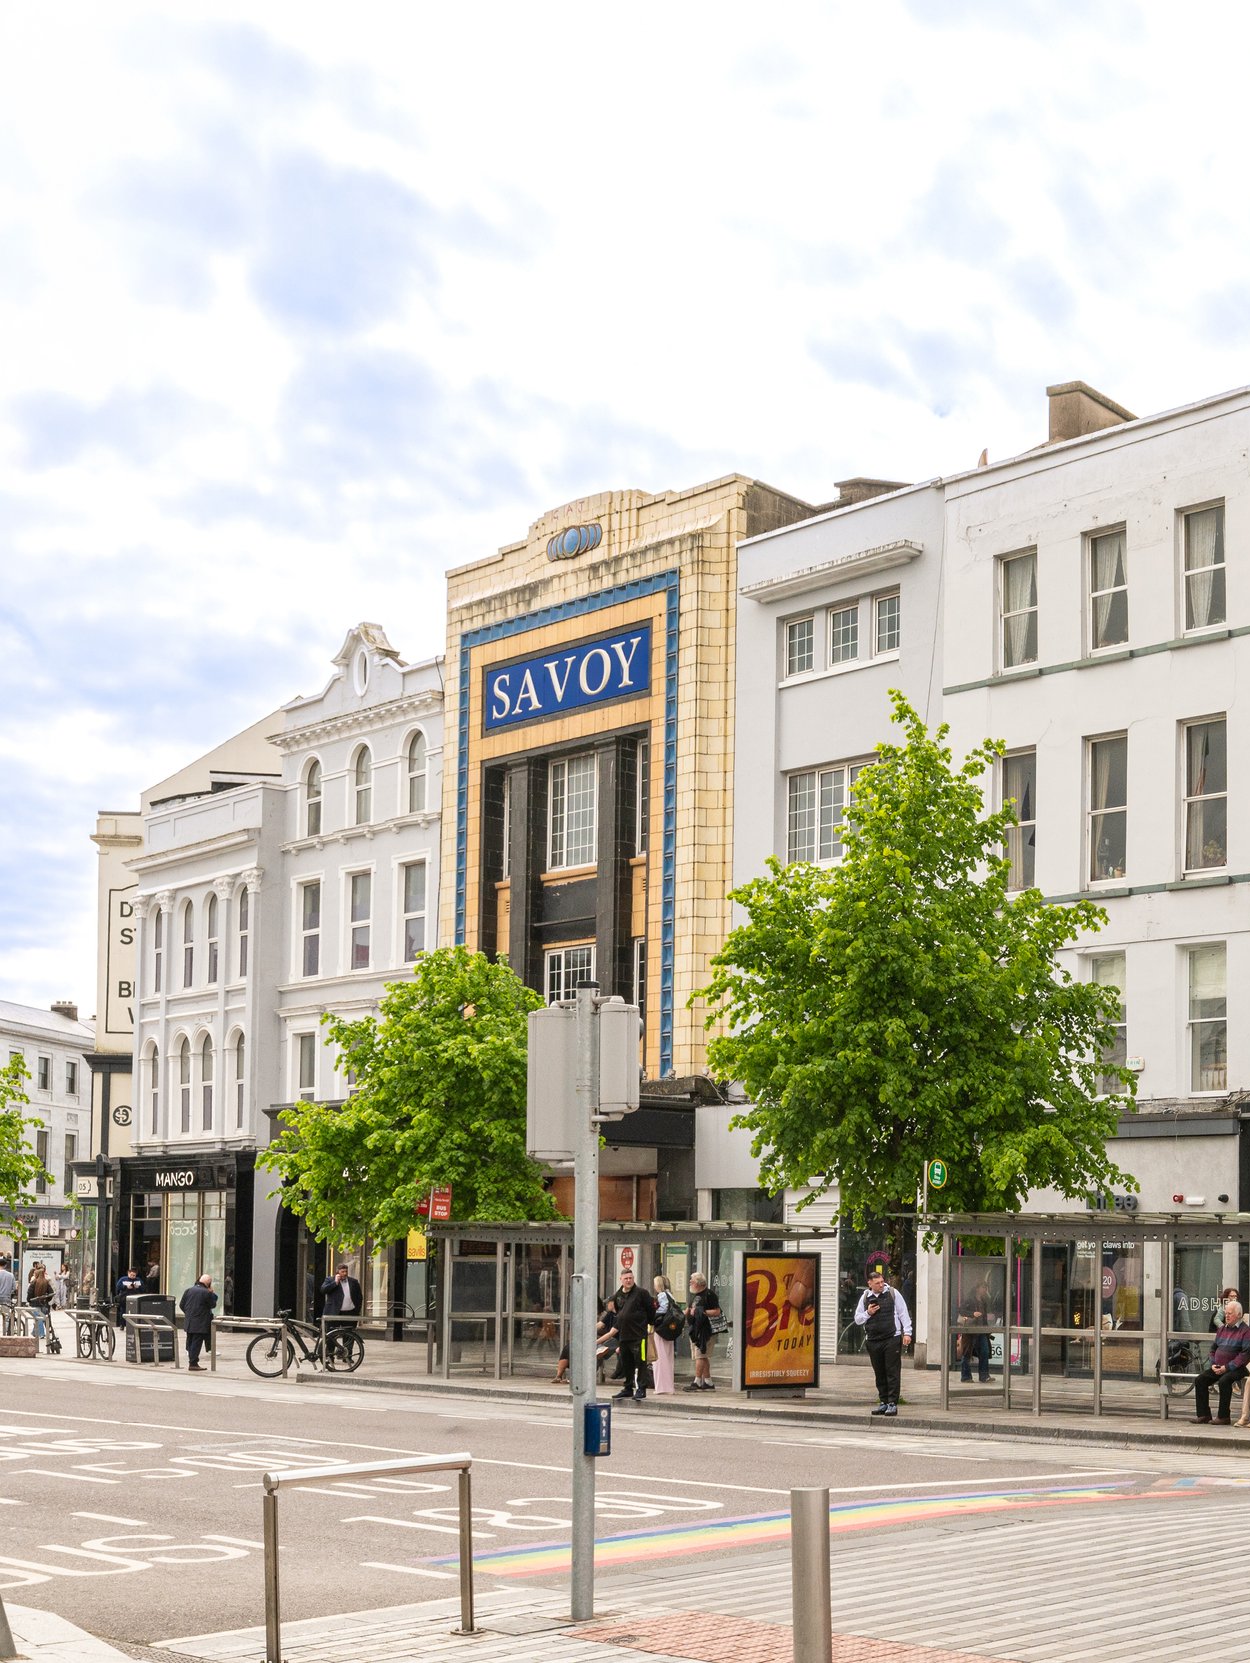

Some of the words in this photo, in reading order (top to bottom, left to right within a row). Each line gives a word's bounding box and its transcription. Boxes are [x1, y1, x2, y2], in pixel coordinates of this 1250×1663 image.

[492, 637, 642, 720] SAVOY
[155, 1171, 194, 1187] MANGO
[1077, 1241, 1088, 1250] get
[1102, 1240, 1121, 1249] claws
[1122, 1240, 1135, 1249] into
[408, 1246, 426, 1258] savills
[713, 1274, 734, 1287] ADS
[1102, 1275, 1112, 1286] 20
[1178, 1297, 1237, 1312] ADSHE
[786, 1369, 809, 1377] SQUEEZY
